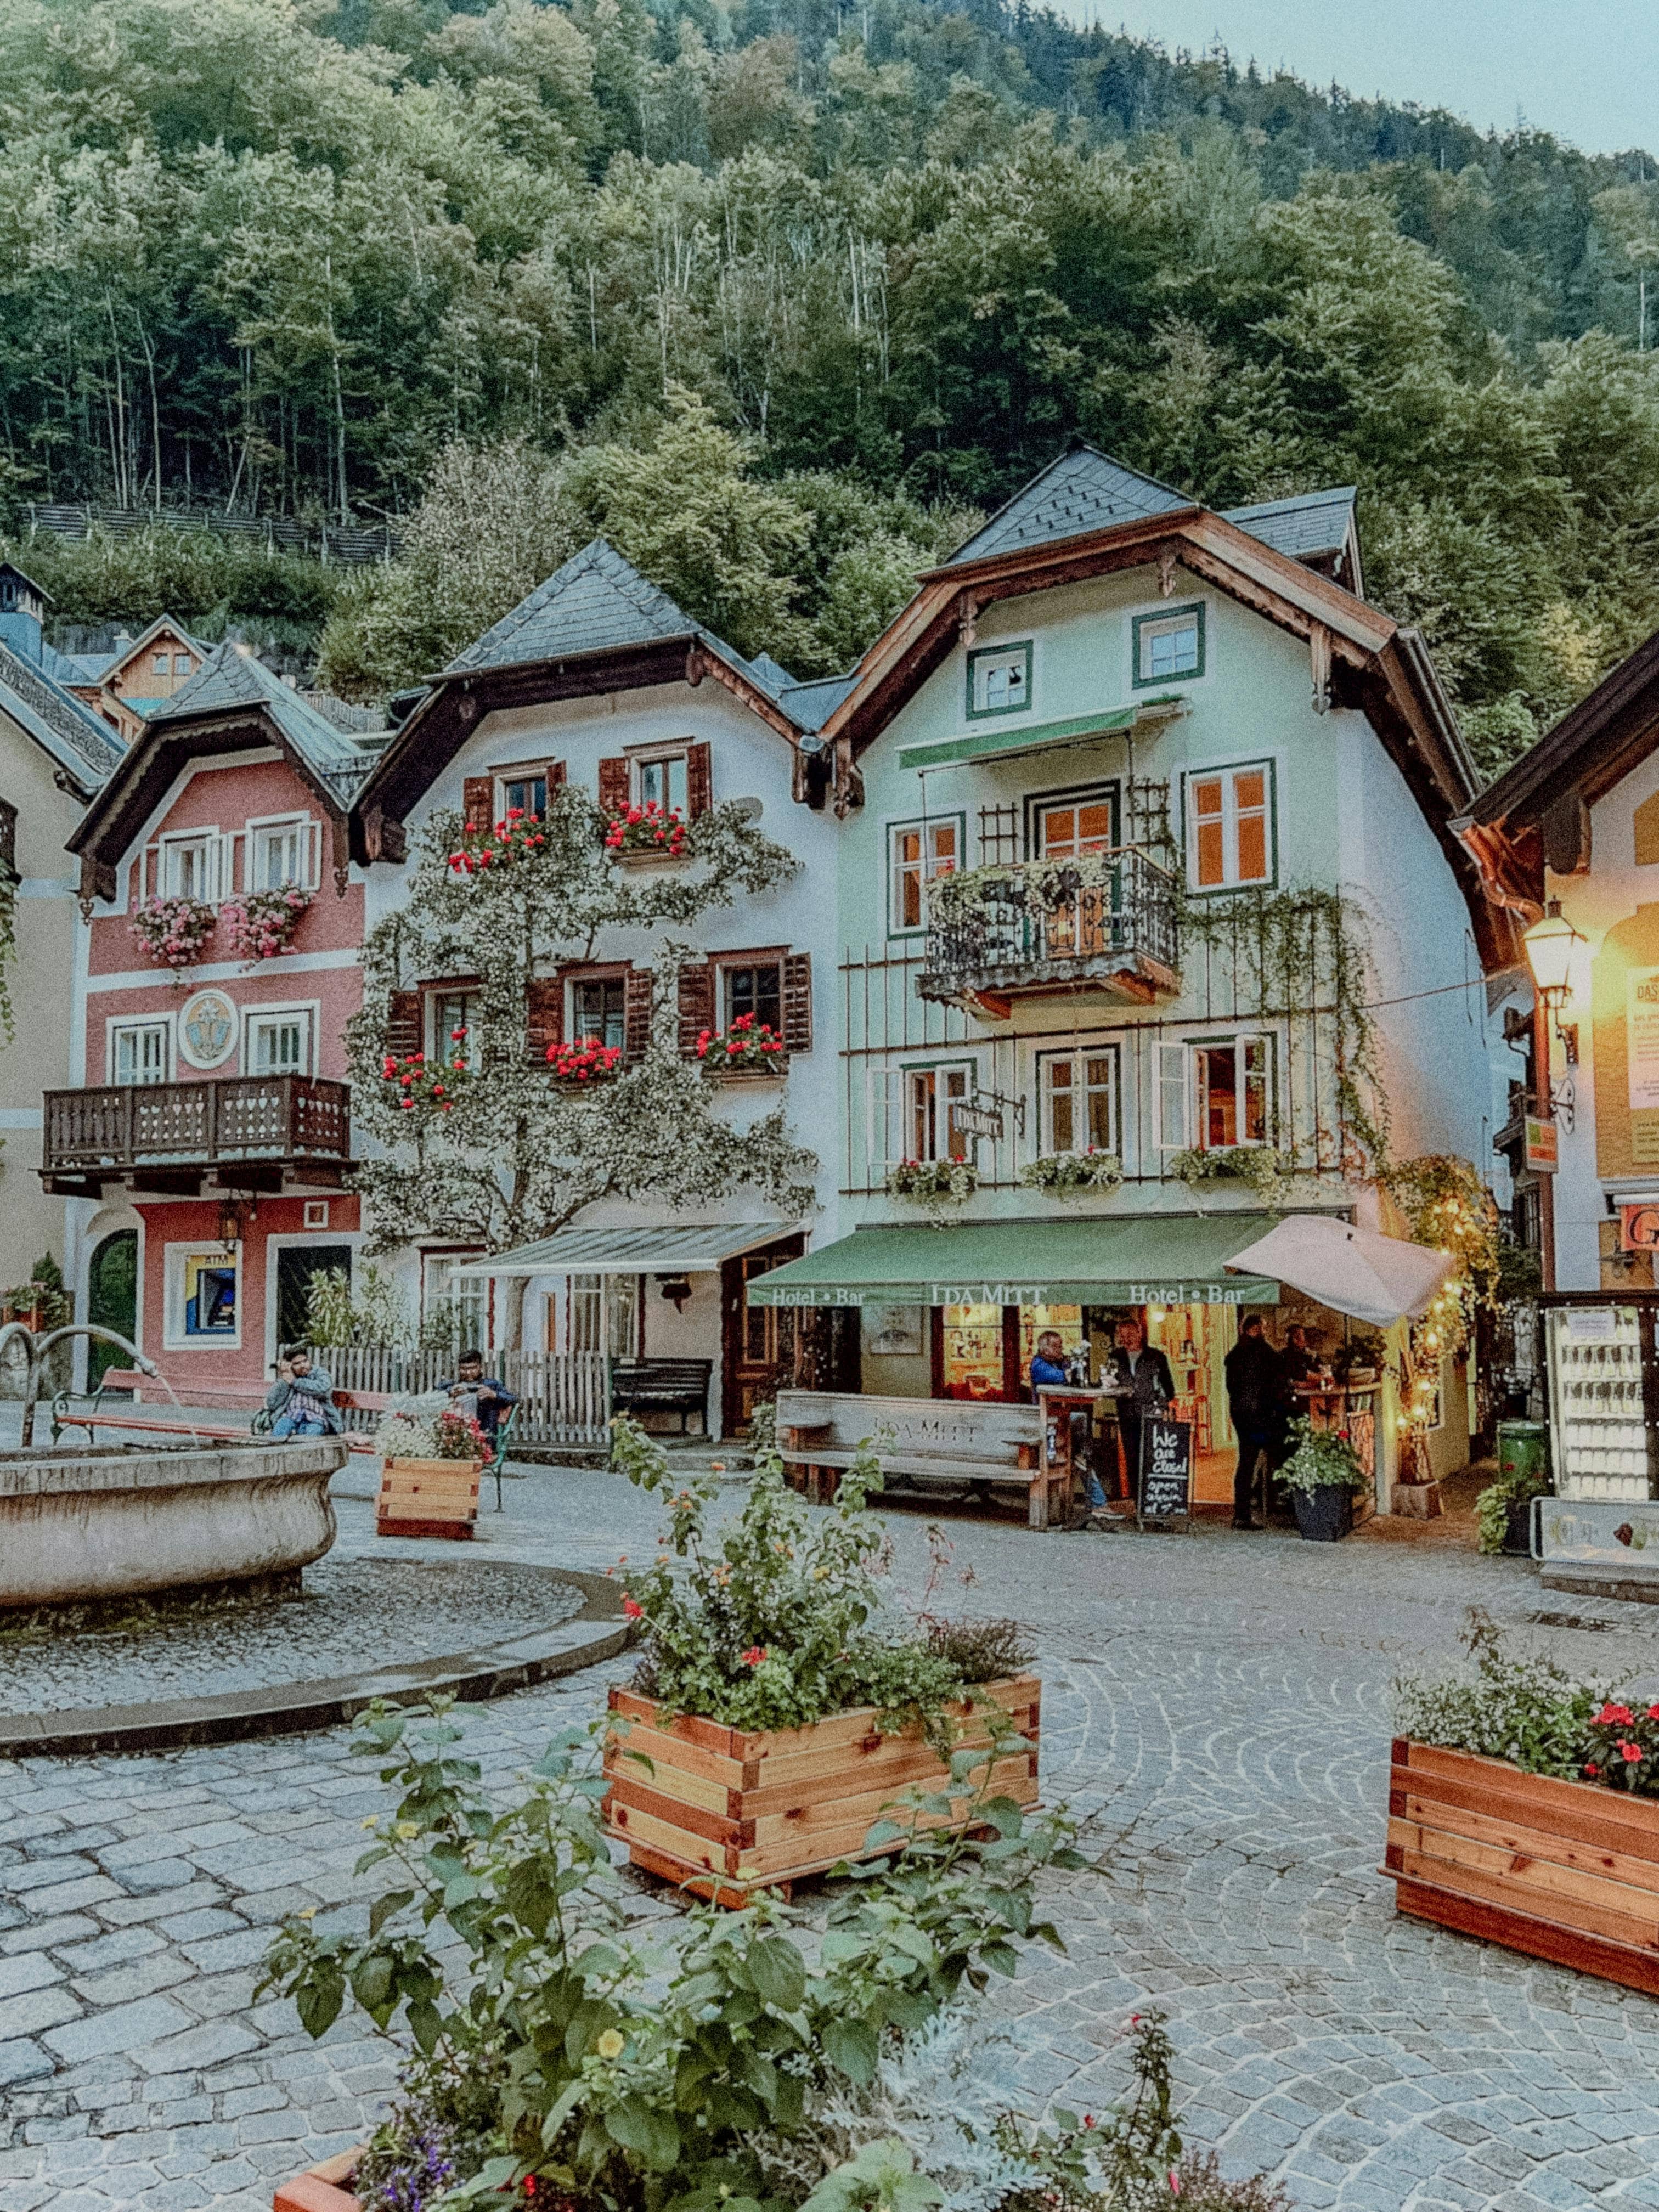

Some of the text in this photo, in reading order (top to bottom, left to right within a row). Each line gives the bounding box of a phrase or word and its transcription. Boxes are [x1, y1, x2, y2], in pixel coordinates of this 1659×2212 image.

[205, 1255, 228, 1265] ATM
[772, 1288, 866, 1306] Hotel Bar
[930, 1284, 1047, 1306] IDA MITT
[1129, 1285, 1245, 1305] Hotel Bar
